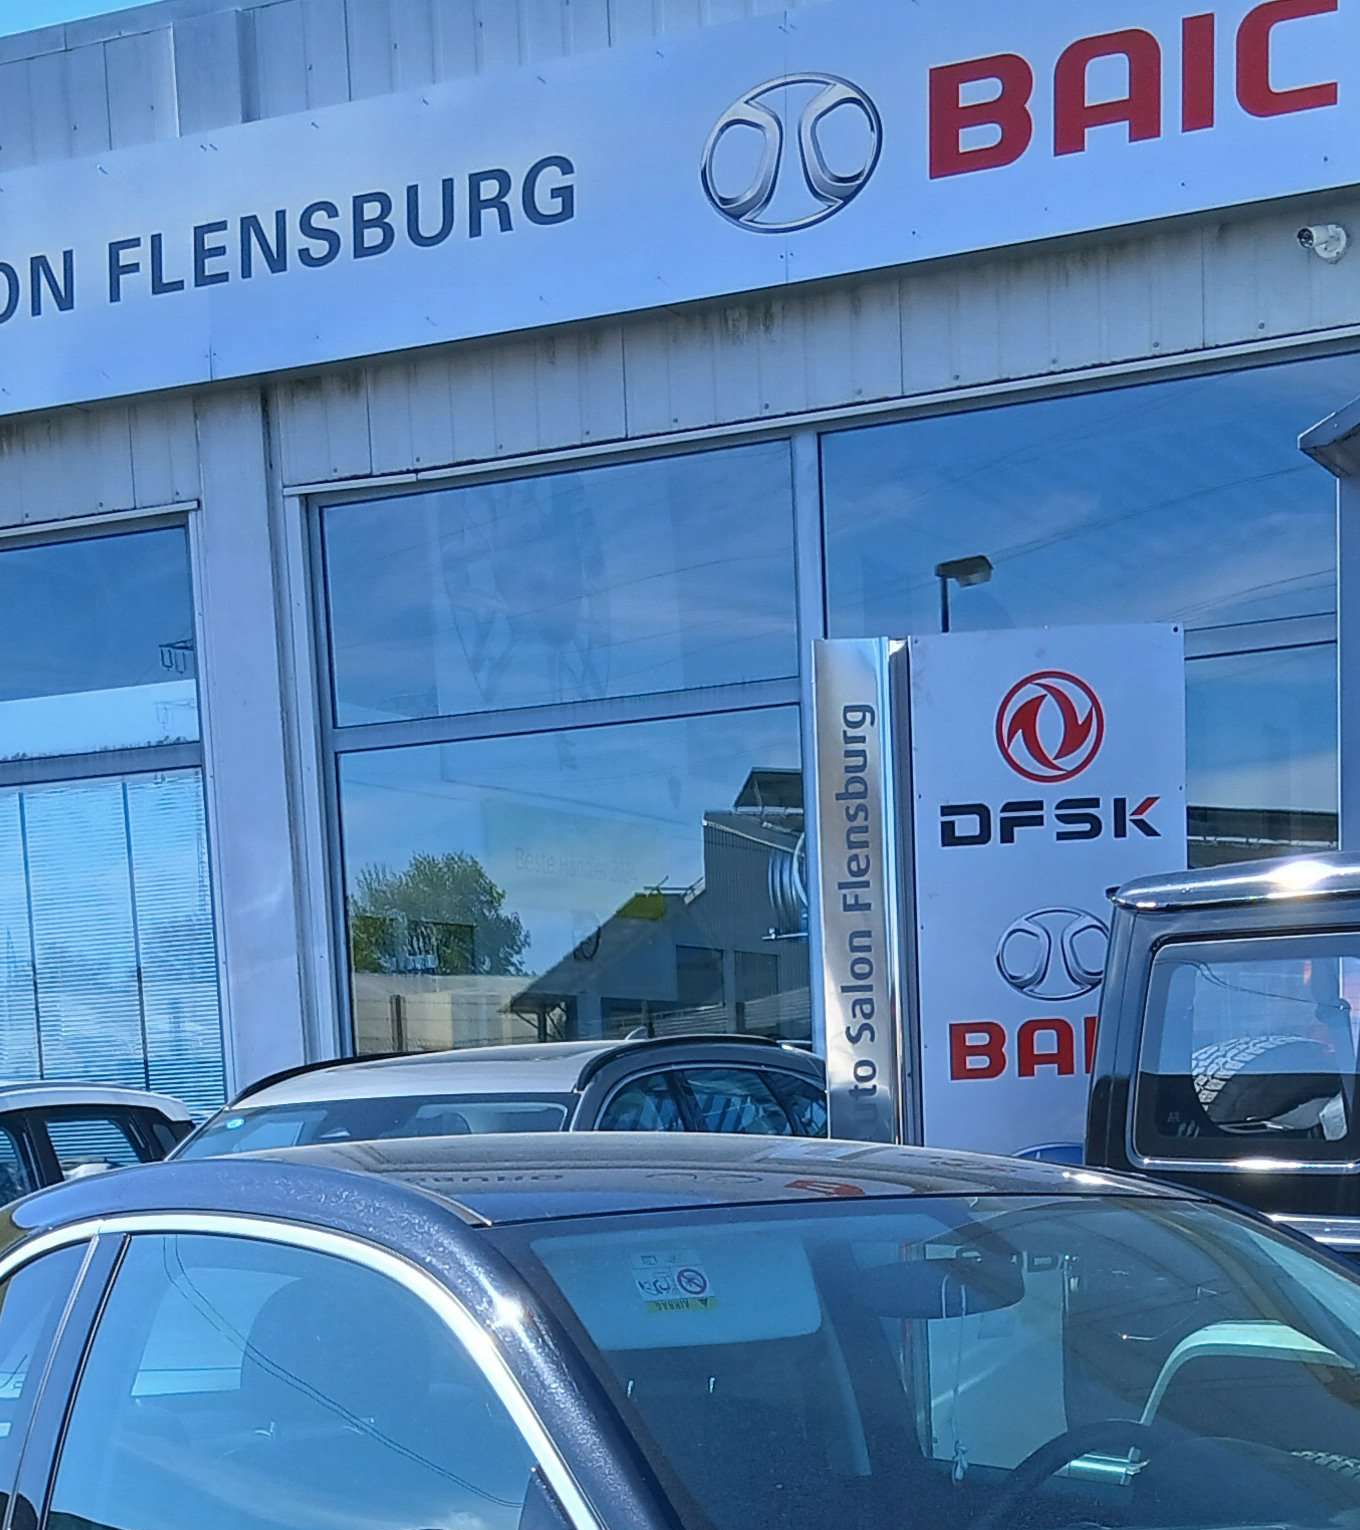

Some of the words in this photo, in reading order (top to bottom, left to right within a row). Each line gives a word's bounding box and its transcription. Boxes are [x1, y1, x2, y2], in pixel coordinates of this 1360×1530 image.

[928, 0, 1338, 180] BAIC
[108, 154, 576, 304] FLENSBURG
[836, 703, 876, 912] Flensburg
[940, 796, 1162, 847] DFSK
[840, 930, 875, 1043] Salon
[847, 1058, 878, 1124] uto
[948, 1015, 1099, 1082] BAI
